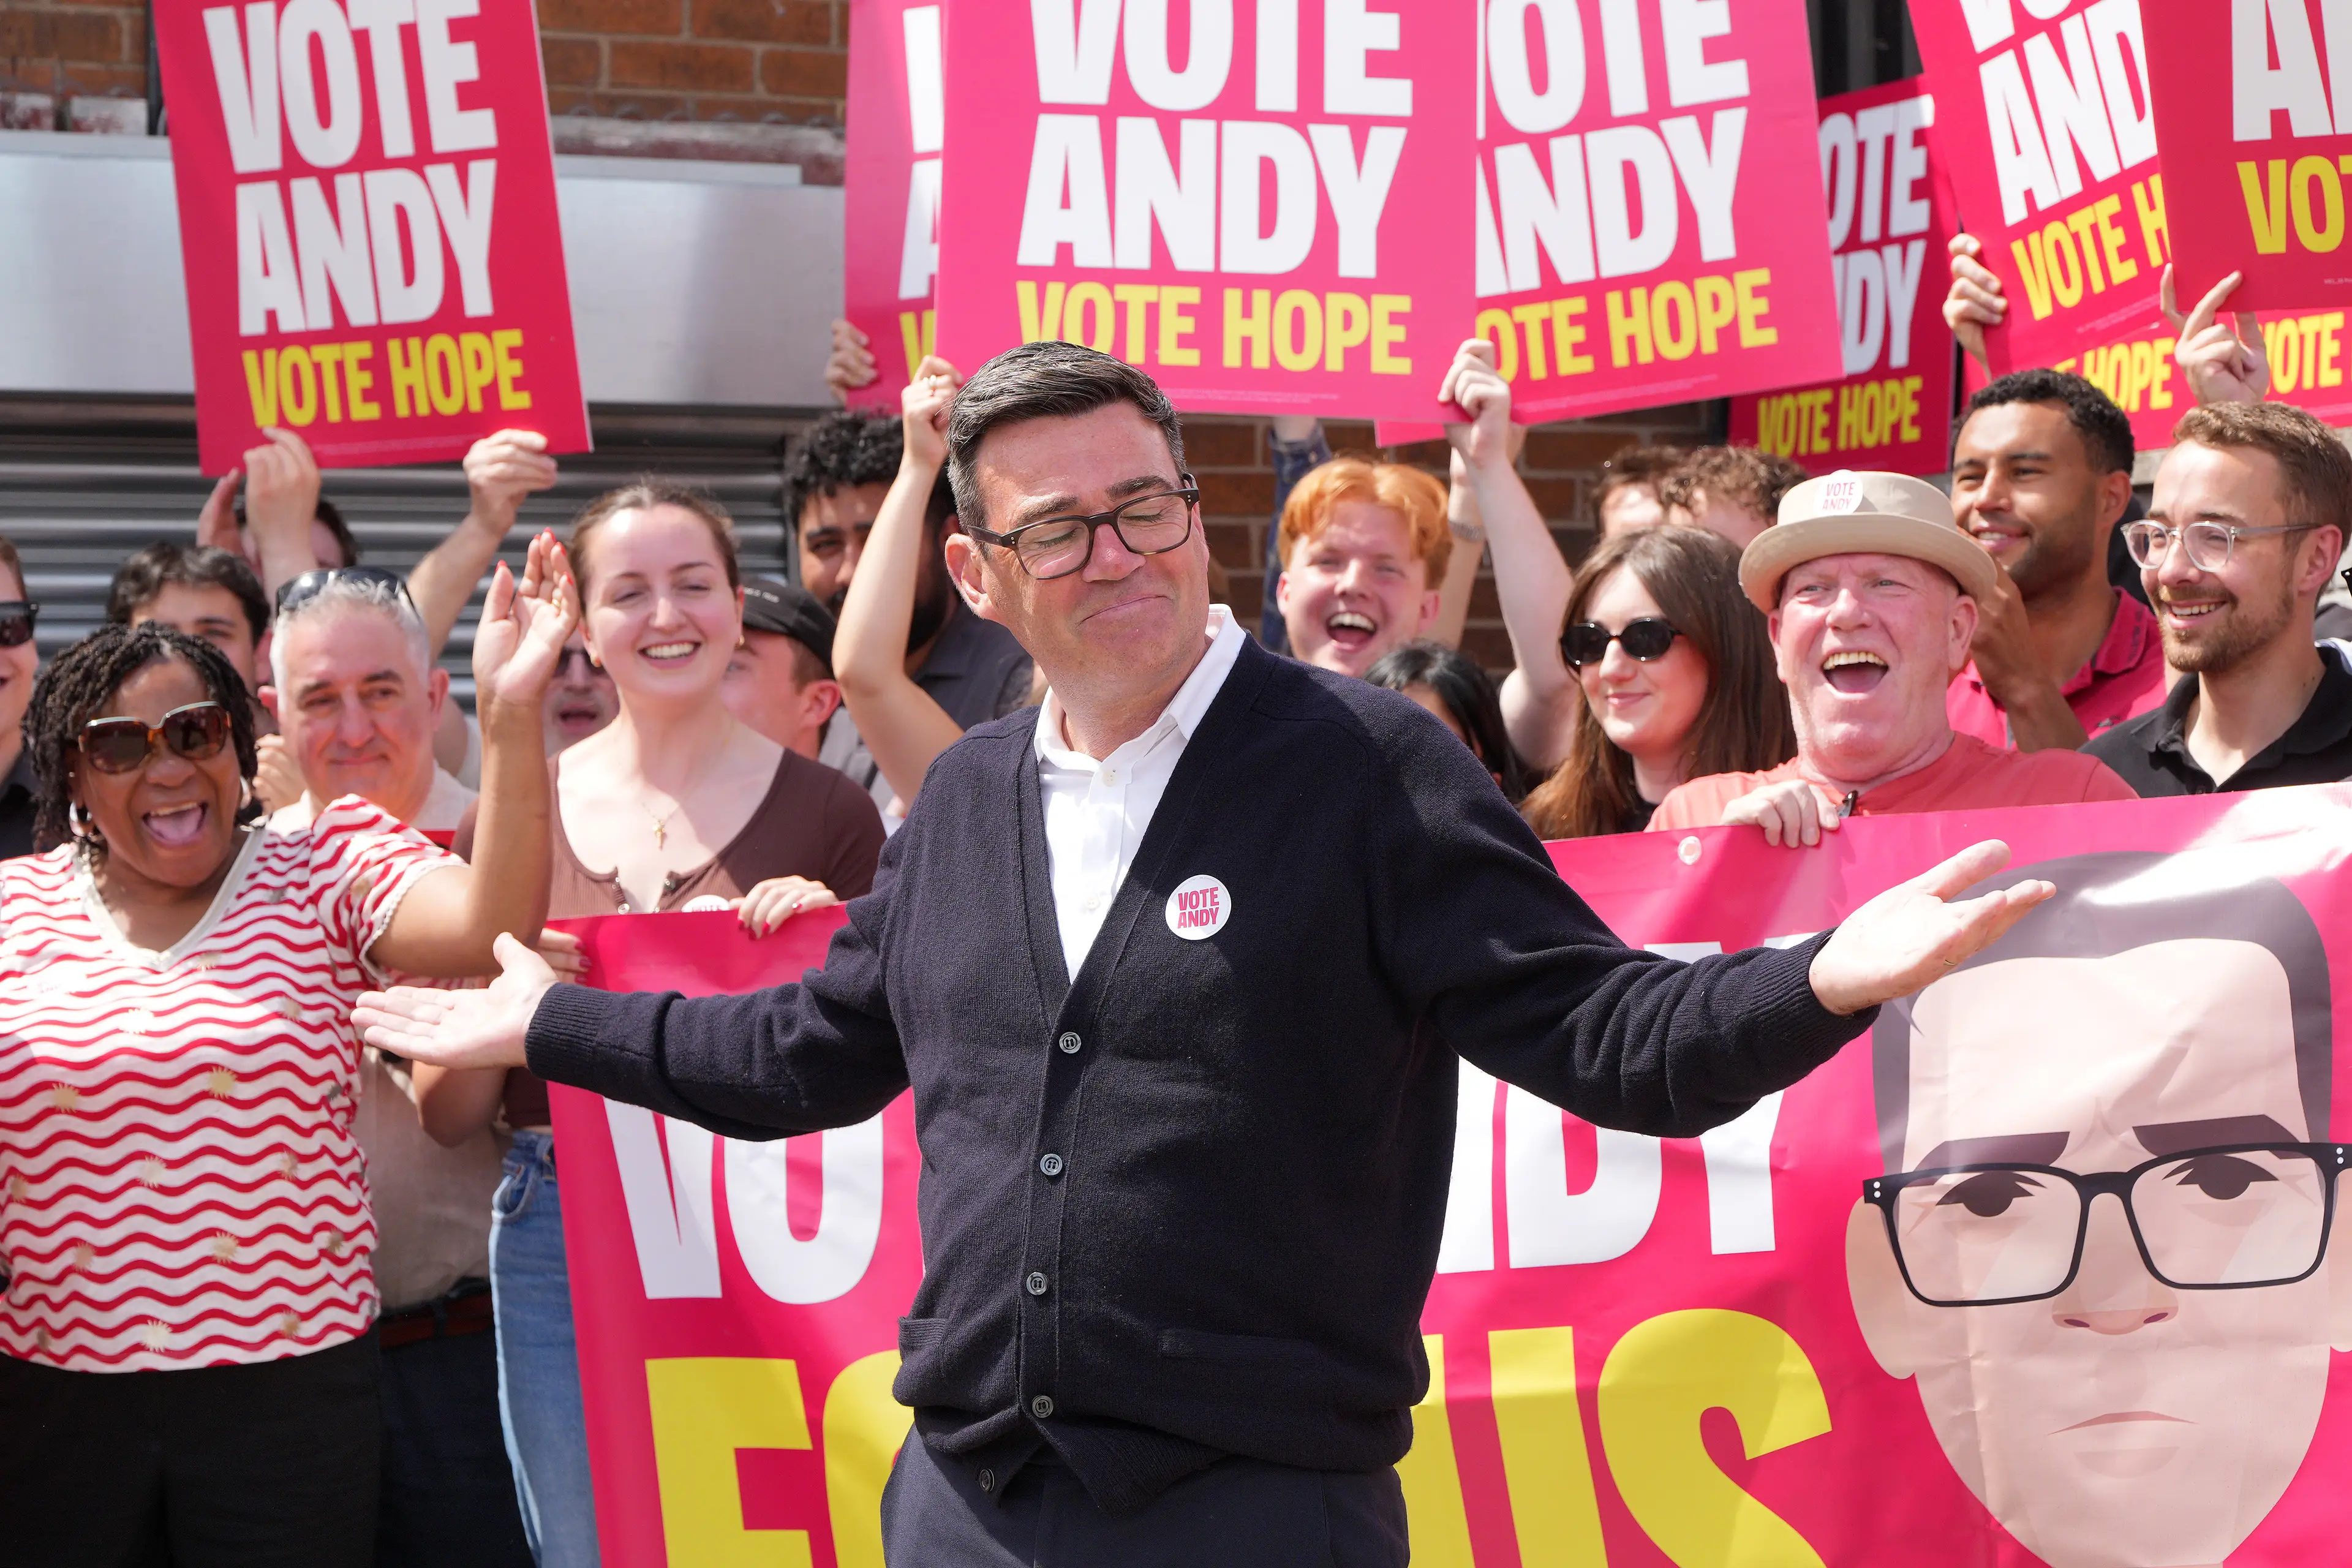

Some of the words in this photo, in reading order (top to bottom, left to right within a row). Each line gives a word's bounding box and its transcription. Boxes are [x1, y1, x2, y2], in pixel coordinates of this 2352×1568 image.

[202, 0, 499, 175] VOTE
[1477, 0, 1751, 140] OTE
[1978, 0, 2158, 227] AND
[1016, 113, 1408, 279] ANDY
[1817, 93, 1936, 251] OTE
[235, 158, 497, 337] ANDY
[2010, 192, 2139, 322] VOTE
[241, 341, 381, 429] VOTE
[387, 328, 532, 417] HOPE
[1016, 280, 1201, 366] VOTE
[1222, 288, 1413, 375] HOPE
[1476, 296, 1595, 385] OTE
[1605, 268, 1778, 368] HOPE
[1757, 388, 1834, 458] VOTE
[1837, 375, 1923, 452] HOPE
[1822, 498, 1852, 511] ANDY
[1826, 482, 1855, 496] VOTE
[1177, 907, 1219, 929] ANDY
[1178, 886, 1219, 911] VOTE
